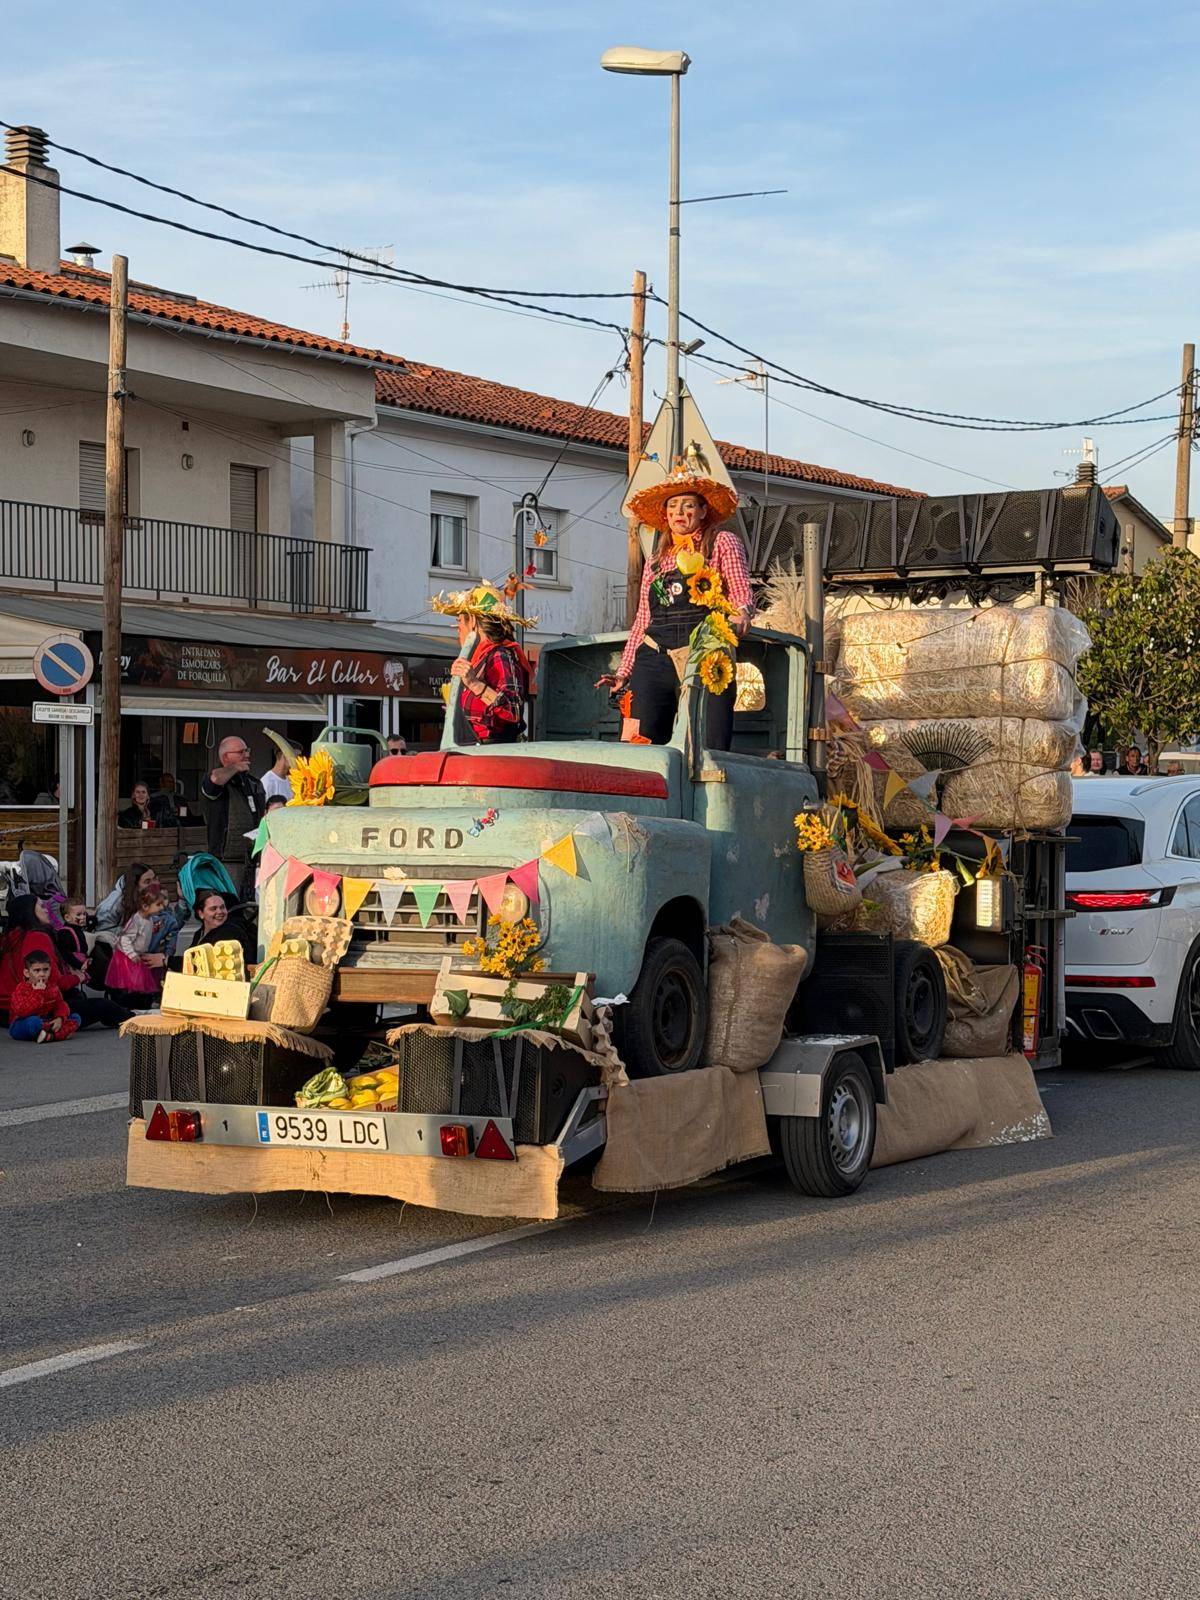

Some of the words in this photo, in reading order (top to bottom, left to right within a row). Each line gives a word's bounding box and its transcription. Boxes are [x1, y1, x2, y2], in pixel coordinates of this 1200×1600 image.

[181, 646, 221, 658] ENTREPANS
[181, 658, 221, 670] ESMORZARS
[265, 655, 302, 683] Bar
[307, 659, 327, 685] El
[331, 659, 379, 685] Celler
[177, 670, 187, 681] DE
[188, 671, 227, 684] FORQUILLA
[361, 827, 464, 849] FORD
[275, 1115, 328, 1142] 9539
[339, 1119, 380, 1145] LDC
